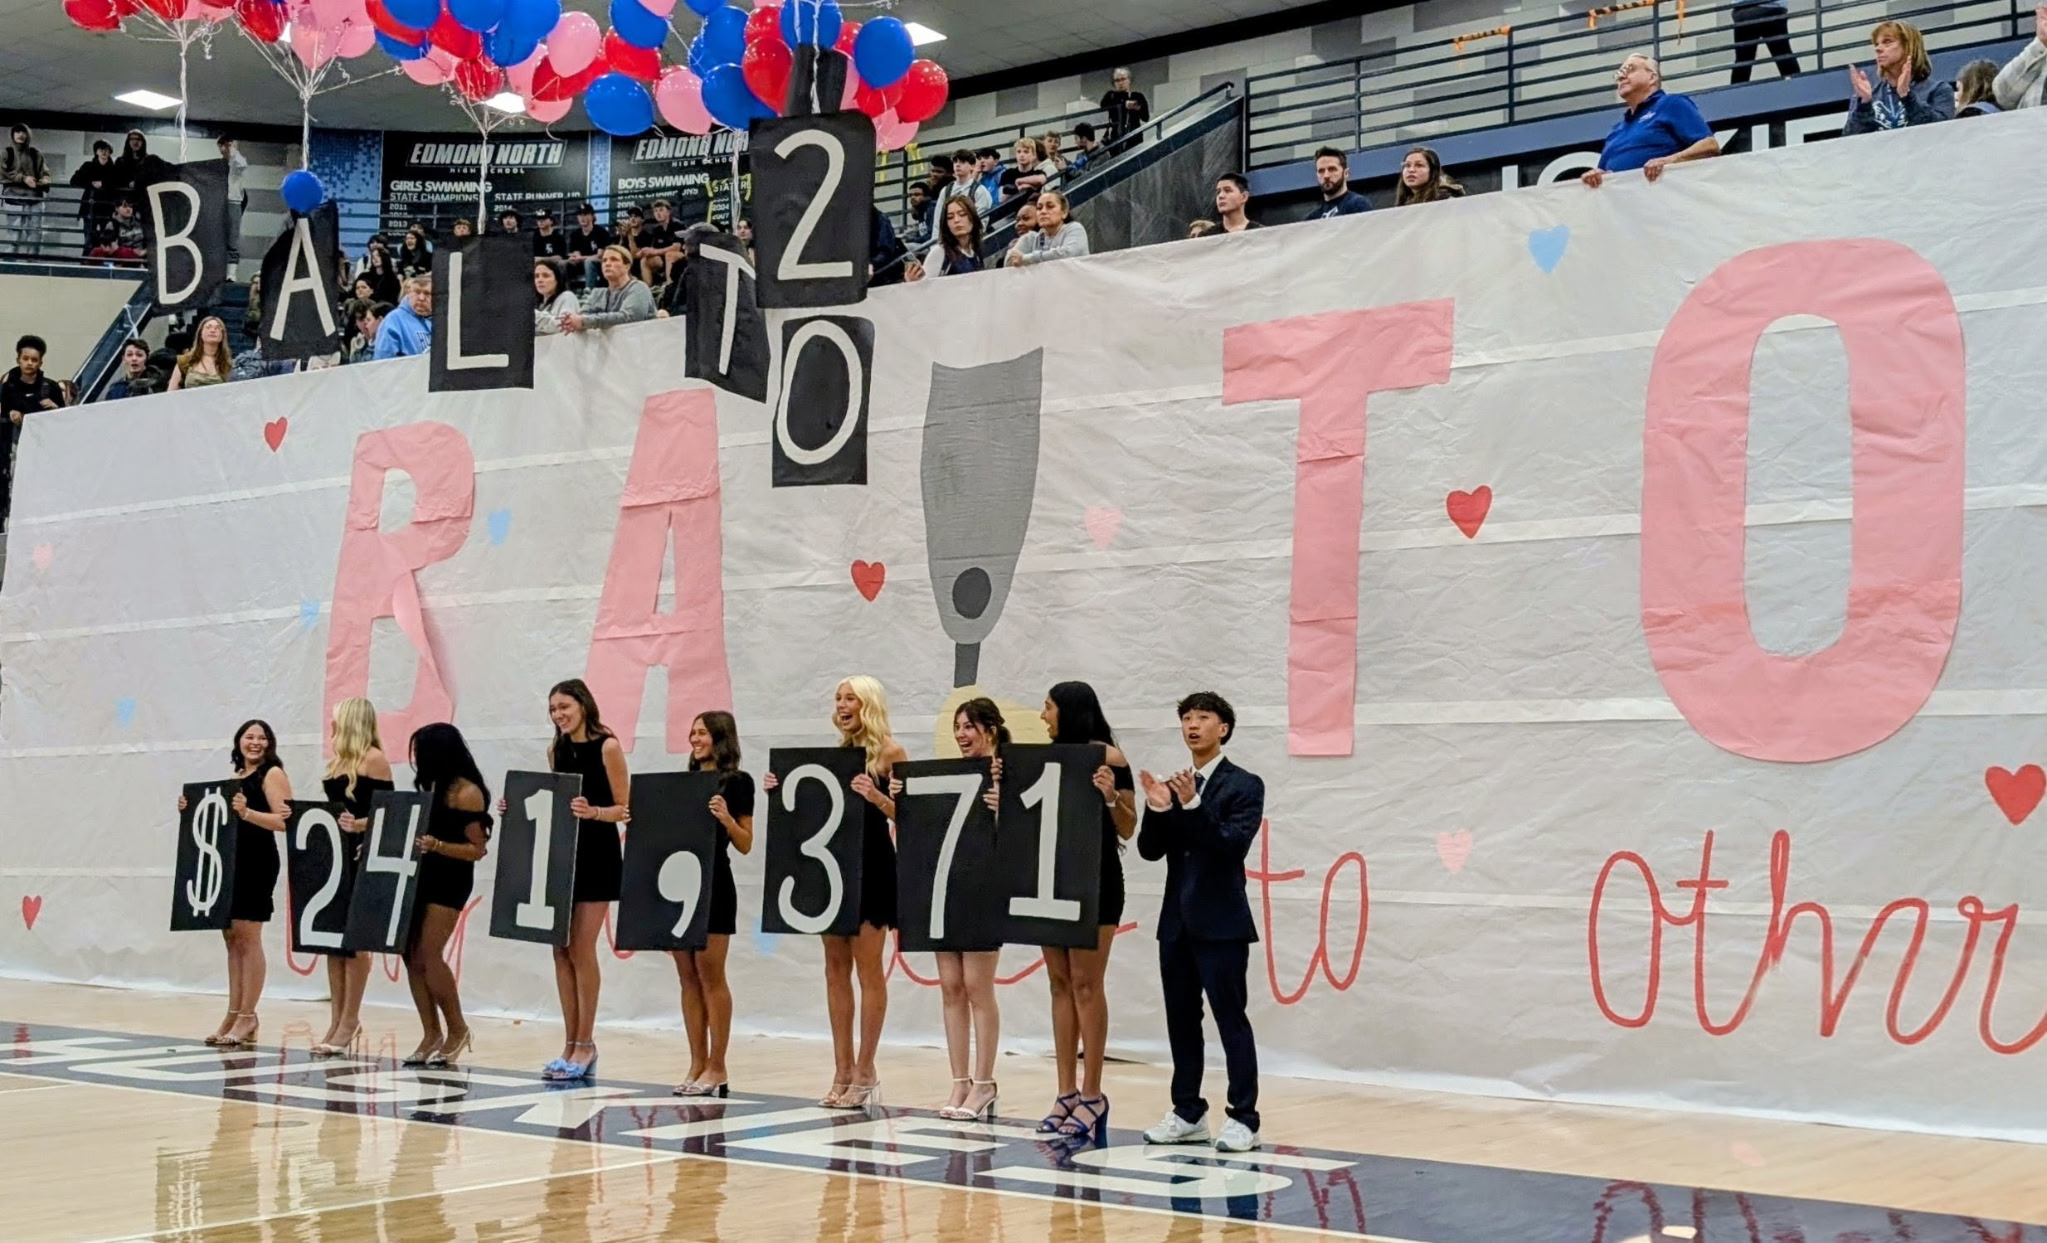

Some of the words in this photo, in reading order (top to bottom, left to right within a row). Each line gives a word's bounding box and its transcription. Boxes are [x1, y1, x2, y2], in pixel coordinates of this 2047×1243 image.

[410, 143, 496, 165] EDMOND
[495, 143, 563, 165] NORTH
[635, 133, 713, 161] EDMOND
[671, 159, 696, 168] HIGH
[390, 180, 423, 192] GIRLS
[424, 180, 493, 193] SWIMMING
[617, 177, 647, 190] BOYS
[647, 172, 710, 189] SWIMMING
[389, 192, 419, 202] STATE
